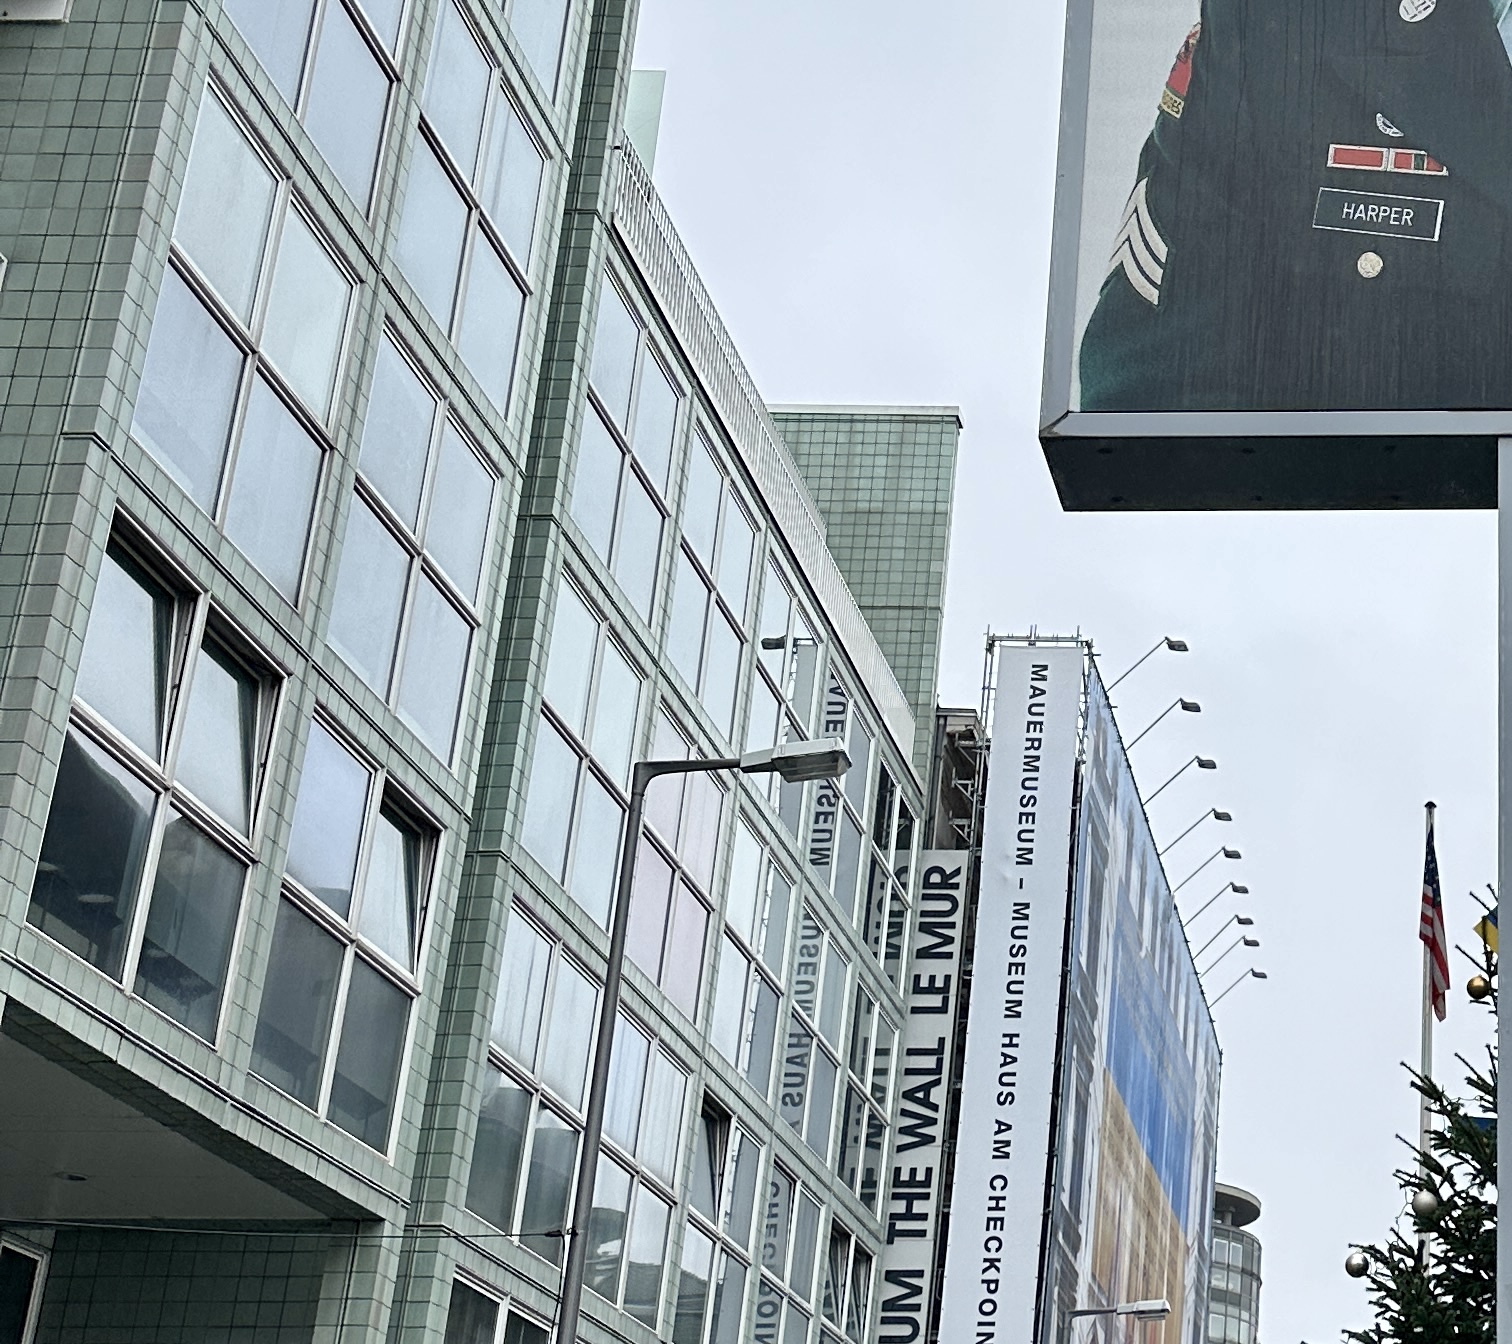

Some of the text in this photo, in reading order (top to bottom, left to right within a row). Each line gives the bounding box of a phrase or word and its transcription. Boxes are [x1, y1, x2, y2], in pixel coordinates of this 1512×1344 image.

[1342, 202, 1414, 226] HARPER
[1015, 664, 1049, 867] MAUERMUSEUM
[915, 864, 963, 960] MUR
[910, 972, 952, 1014] LE
[1003, 902, 1031, 1020] MUSEUM
[896, 1037, 945, 1153] WALL
[996, 1033, 1020, 1107] HAUS
[992, 1118, 1013, 1159] AM
[887, 1165, 934, 1245] THE
